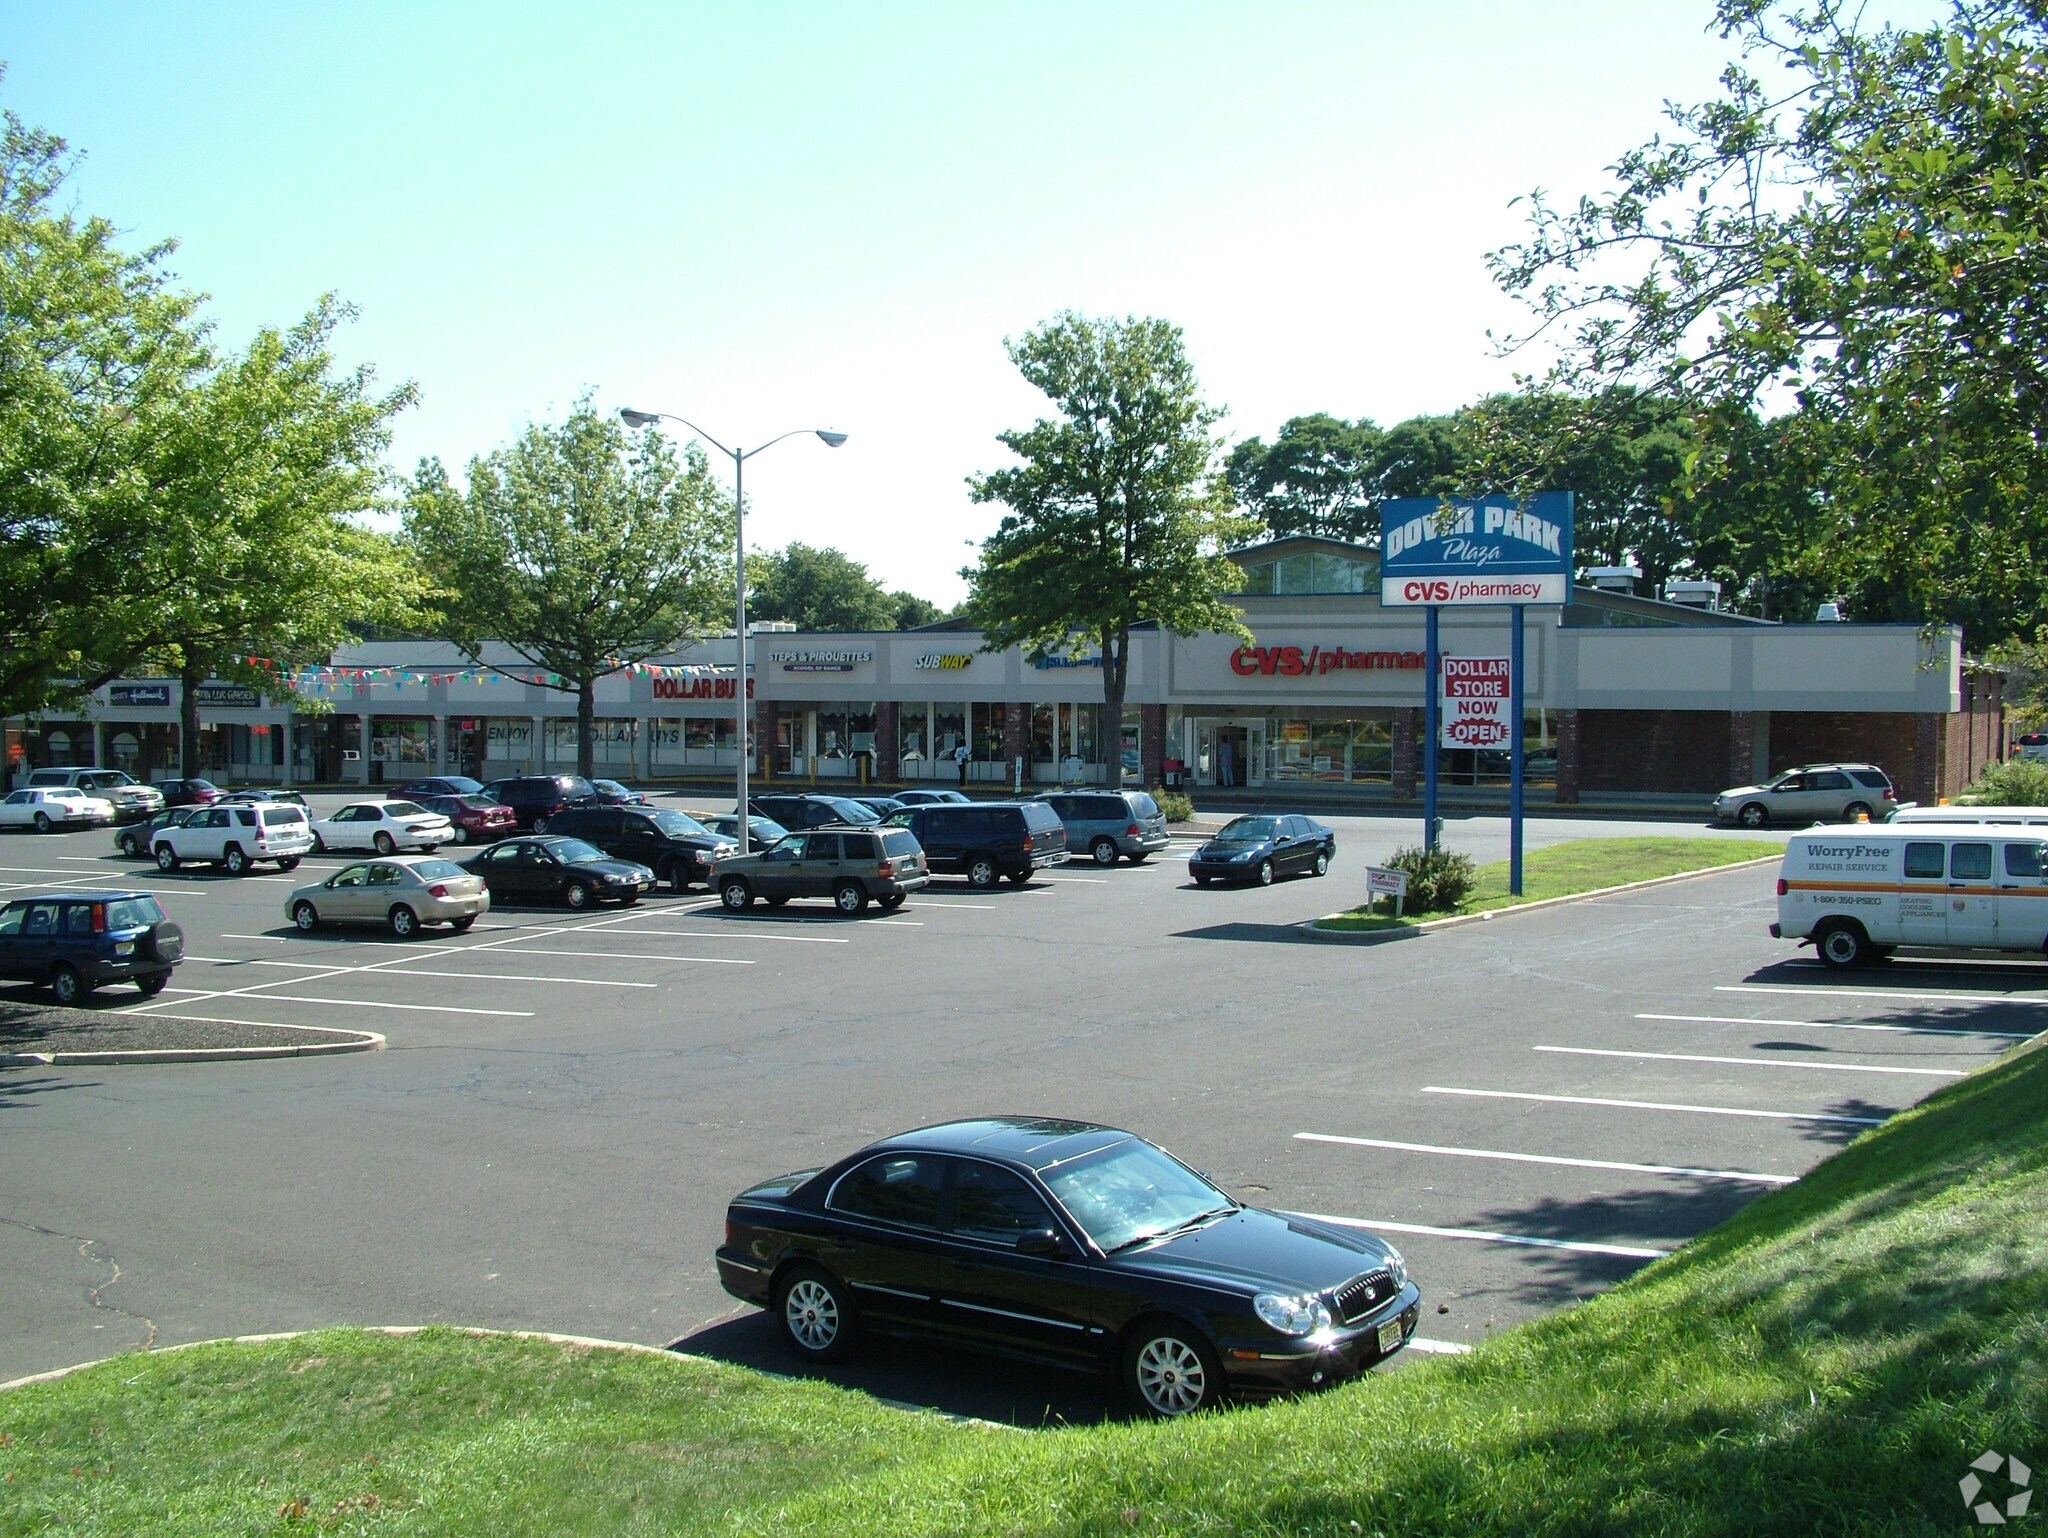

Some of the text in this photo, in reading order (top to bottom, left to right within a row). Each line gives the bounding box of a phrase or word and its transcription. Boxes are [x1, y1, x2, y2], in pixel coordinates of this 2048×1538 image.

[1387, 506, 1561, 561] DOVR PARK
[1442, 538, 1502, 567] Plaza
[1404, 581, 1542, 602] CVS/pharmacy
[768, 652, 798, 662] STEPS
[809, 651, 872, 662] PIROUETTES
[915, 654, 973, 669] SUBWAY
[1230, 645, 1449, 676] CVS/pharmac
[1447, 661, 1508, 676] DOLLAR
[653, 678, 755, 699] DOLLAR BUS
[1453, 681, 1502, 696] STORE
[1458, 701, 1498, 714] NOW
[488, 727, 530, 740] ENJOY
[1455, 725, 1501, 740] OPEN
[1808, 845, 1890, 859] WorryFree
[1808, 863, 1888, 872] REPAIR SERVICE
